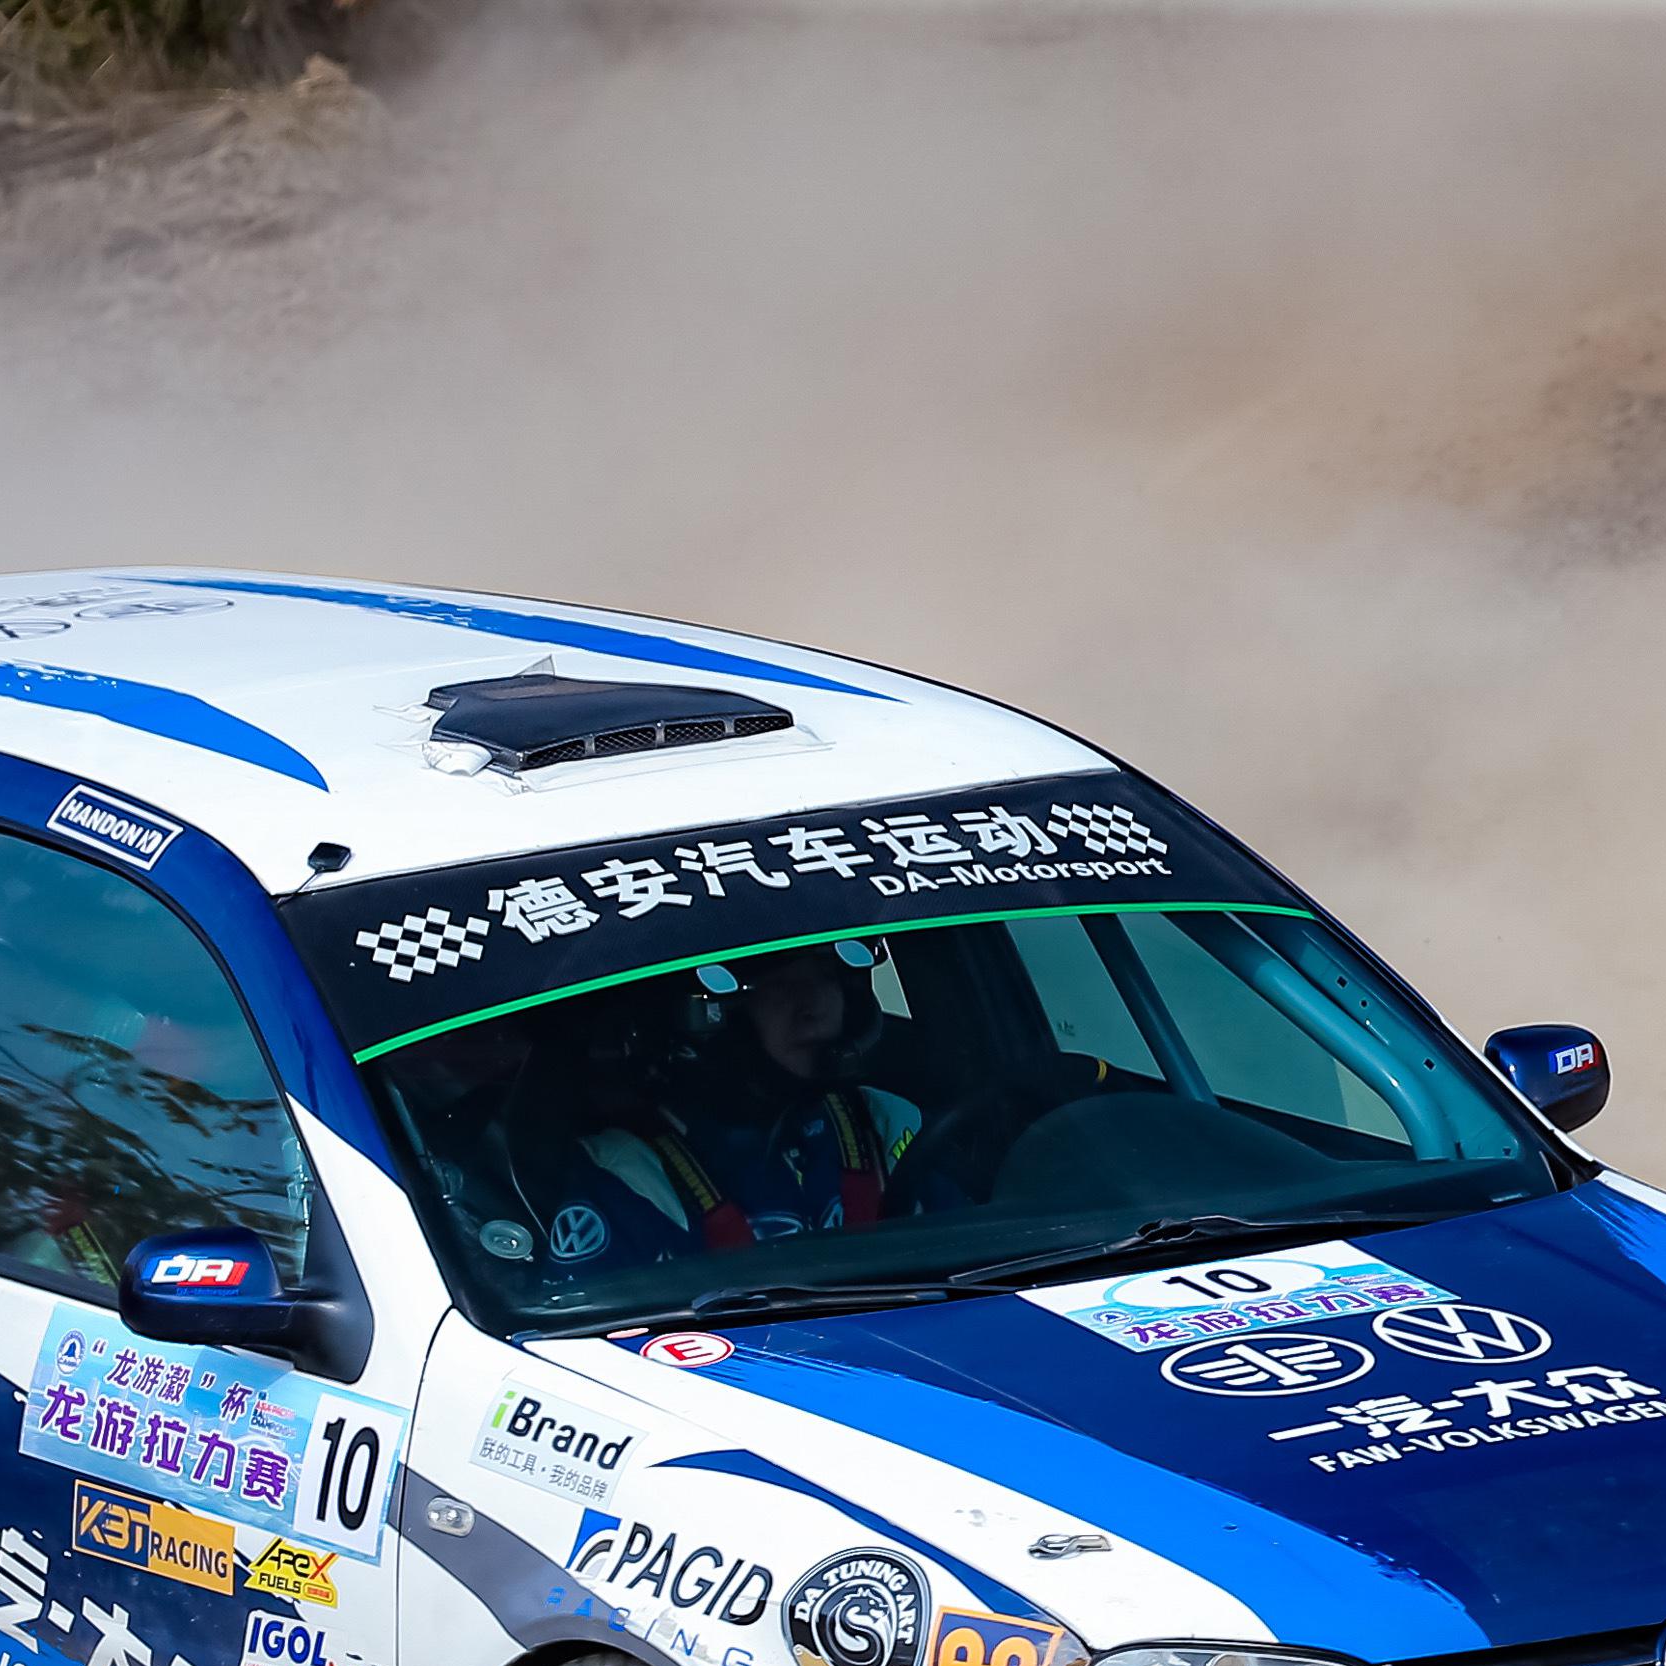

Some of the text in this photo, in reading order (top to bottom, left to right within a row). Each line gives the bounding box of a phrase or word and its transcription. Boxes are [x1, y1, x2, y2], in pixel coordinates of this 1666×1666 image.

[486, 804, 1060, 945] 德安汽车运动
[869, 855, 1172, 897] DA-Motorsport
[1555, 1043, 1594, 1075] DA
[1123, 1284, 1432, 1345] 龙游拉力赛
[1163, 1269, 1271, 1300] 10
[662, 1339, 713, 1361] E
[40, 1384, 290, 1510] 龙游拉力赛
[491, 1390, 634, 1470] iBrand
[315, 1415, 381, 1533] 10
[150, 1532, 229, 1579] RACING
[259, 1573, 302, 1593] FUELS
[614, 1522, 775, 1627] PAGID
[794, 1559, 917, 1645] DA TUNING ART
